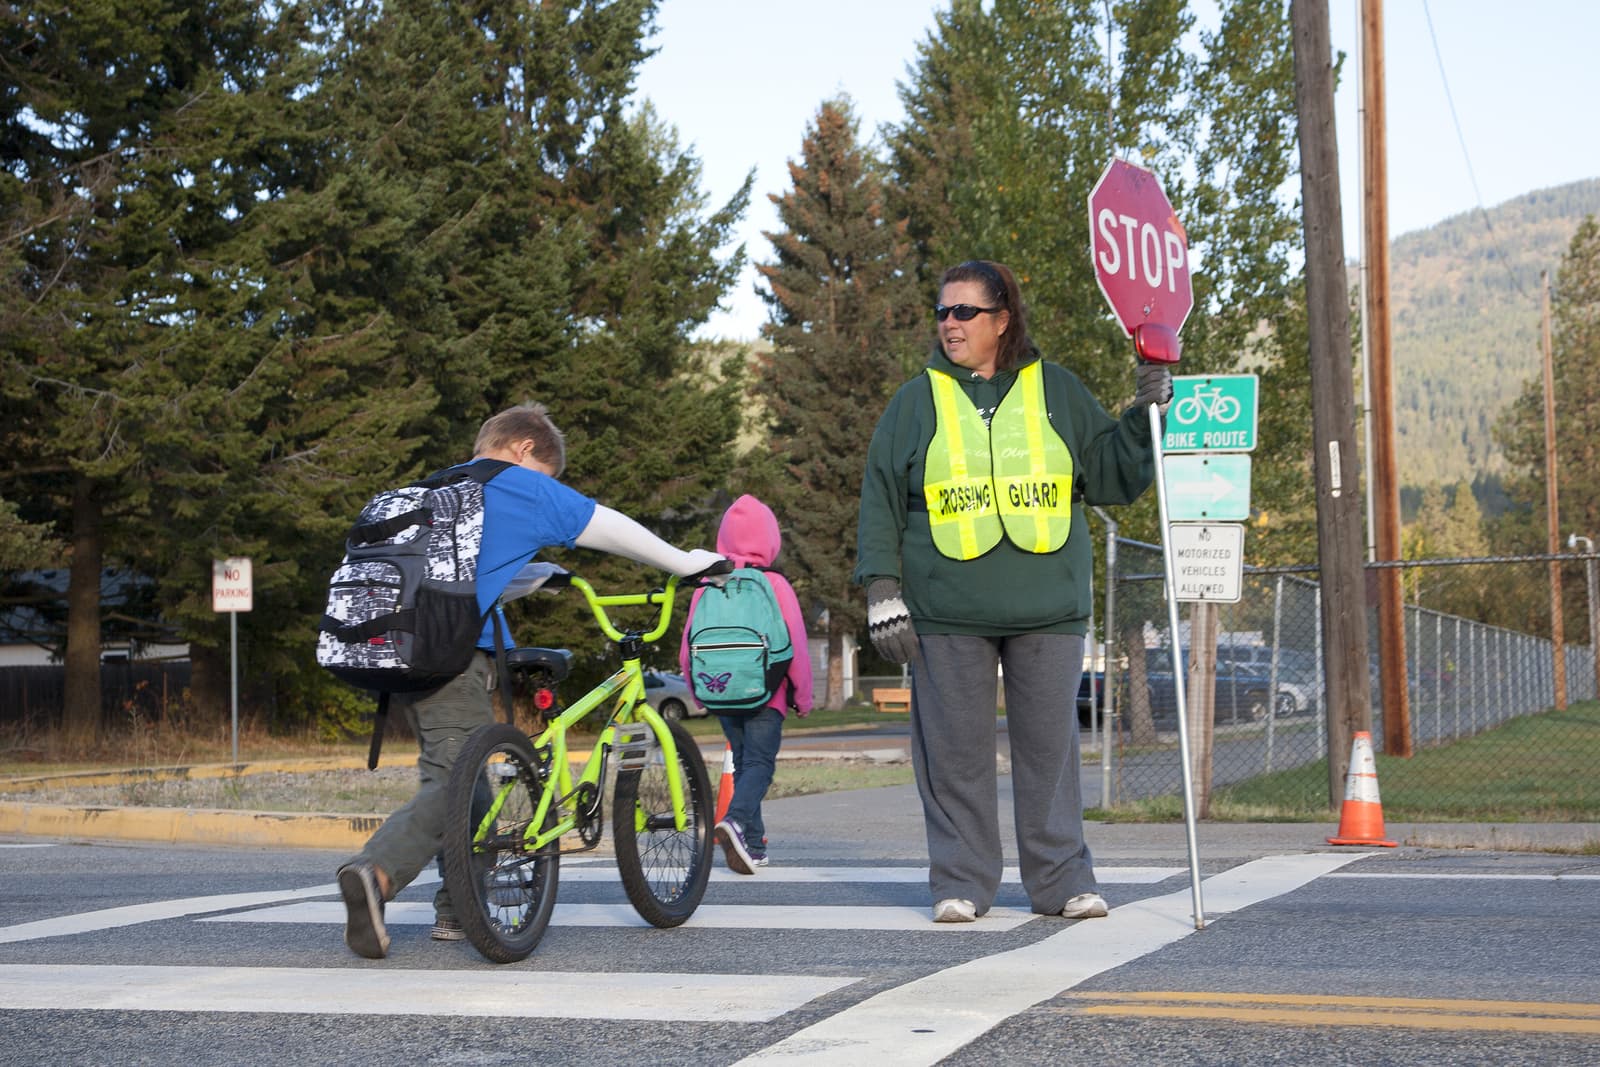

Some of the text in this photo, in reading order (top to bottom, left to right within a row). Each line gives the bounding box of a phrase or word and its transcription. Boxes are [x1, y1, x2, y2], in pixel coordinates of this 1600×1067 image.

[1098, 208, 1184, 293] STOP
[1166, 431, 1248, 448] BIKE ROUTE
[1008, 482, 1058, 508] GUARD
[1198, 531, 1211, 542] NO
[1178, 548, 1231, 559] MOTORIZED
[224, 569, 240, 581] NO
[1181, 566, 1226, 576] VEHICLES
[1181, 583, 1225, 594] ALLOWED
